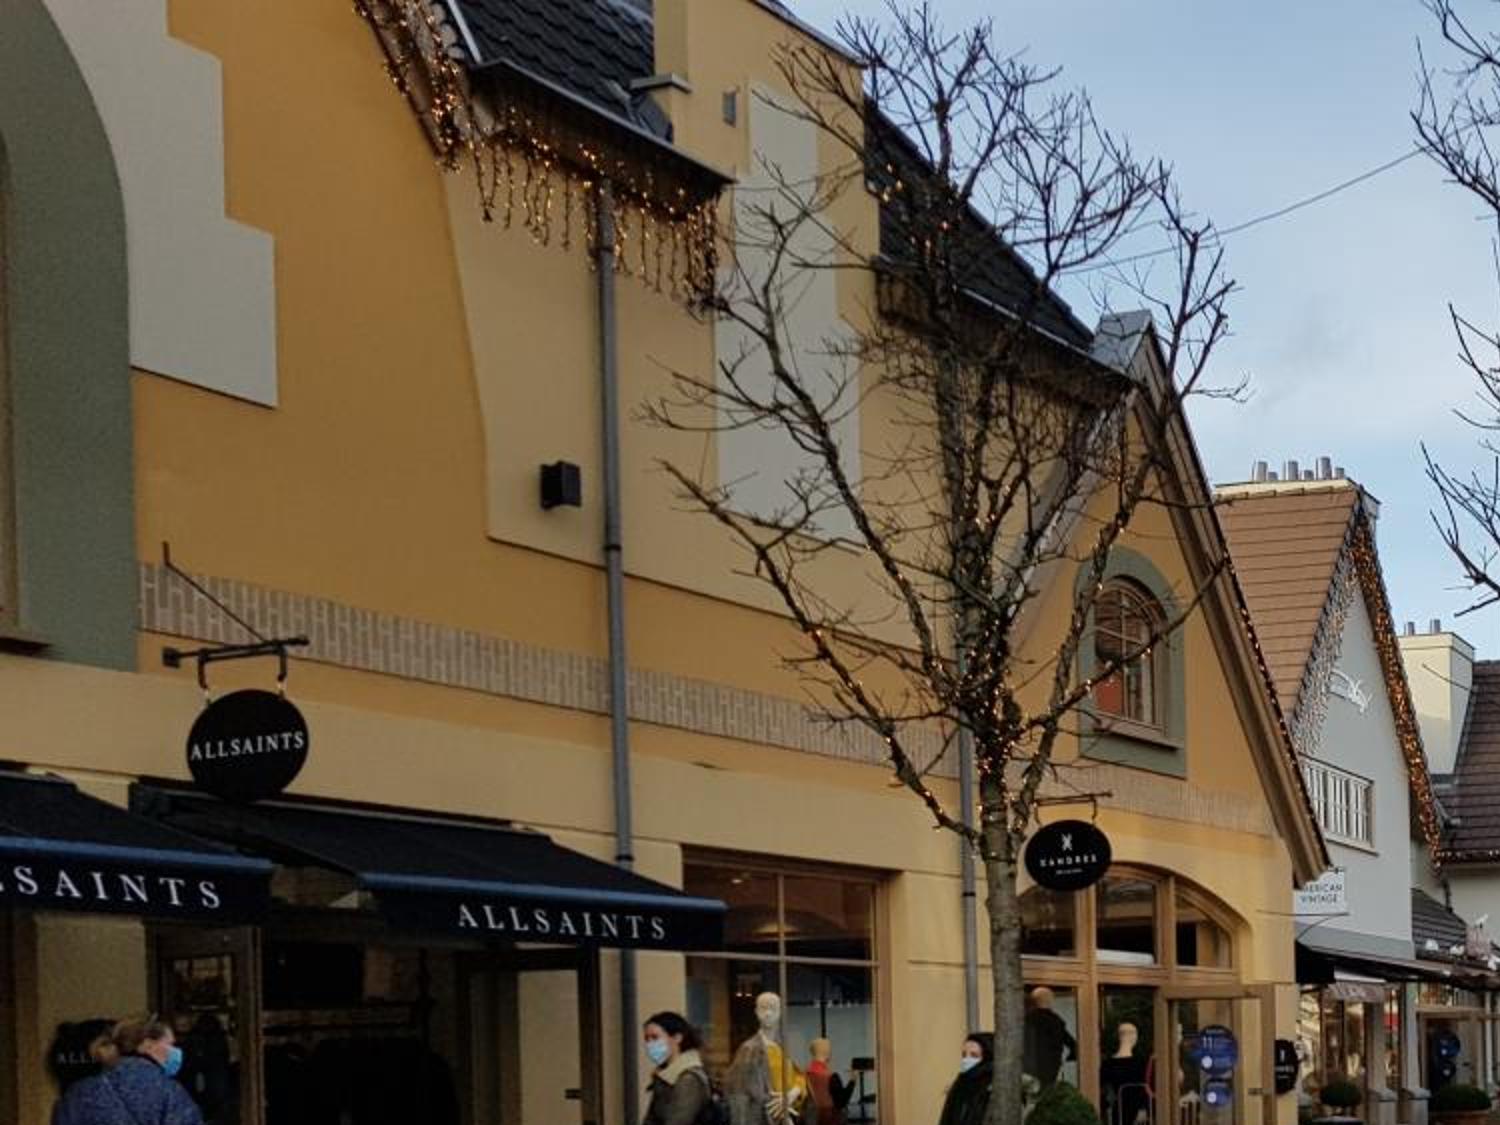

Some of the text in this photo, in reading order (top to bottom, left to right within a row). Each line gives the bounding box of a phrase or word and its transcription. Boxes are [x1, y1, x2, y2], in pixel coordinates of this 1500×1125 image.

[191, 730, 305, 761] ALLSAINTS
[0, 865, 221, 909] SAINTS
[1300, 893, 1337, 903] VINTAGE
[1301, 883, 1343, 893] MERICAN
[458, 903, 666, 940] ALLSAINTS
